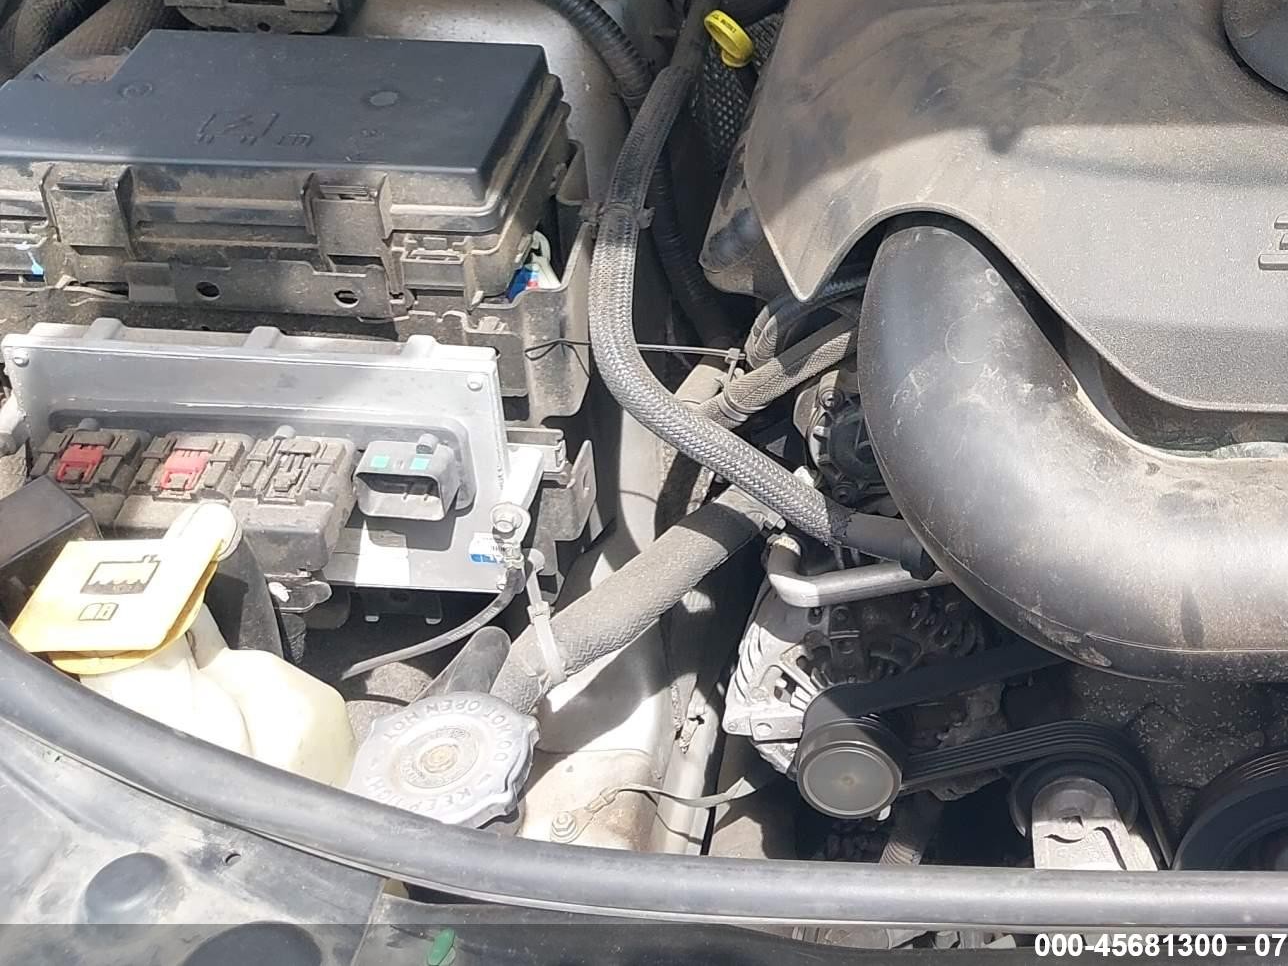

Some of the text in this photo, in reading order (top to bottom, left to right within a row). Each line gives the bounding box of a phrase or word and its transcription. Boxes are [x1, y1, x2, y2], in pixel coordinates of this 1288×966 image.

[425, 698, 483, 715] OPEN
[383, 711, 421, 741] HOT
[483, 706, 513, 735] NOT
[493, 739, 514, 763] DO
